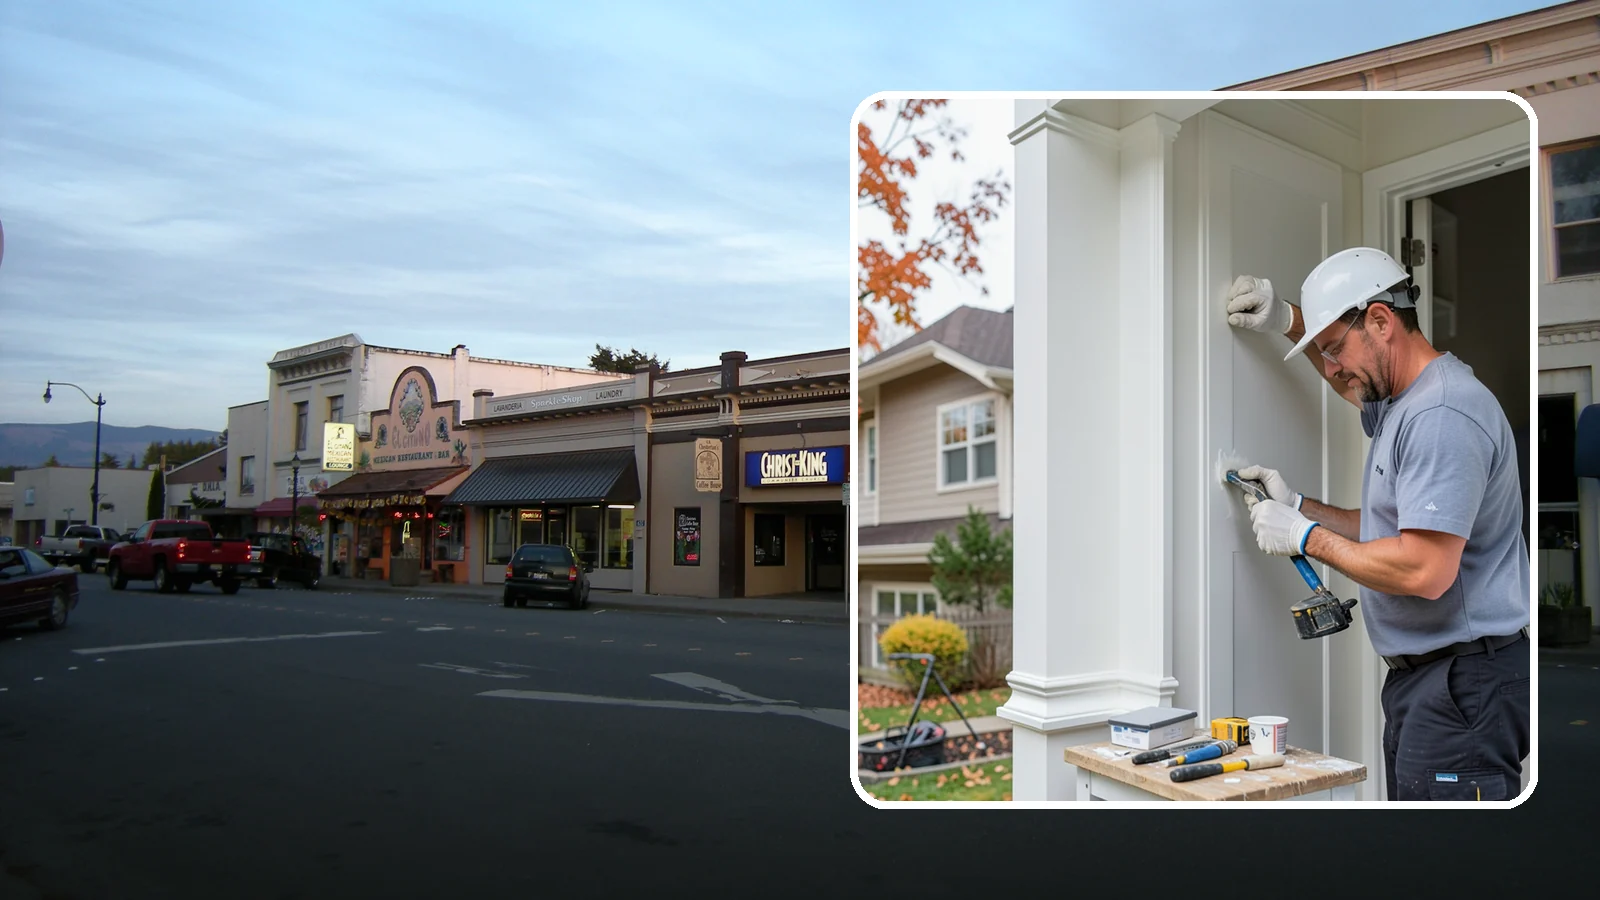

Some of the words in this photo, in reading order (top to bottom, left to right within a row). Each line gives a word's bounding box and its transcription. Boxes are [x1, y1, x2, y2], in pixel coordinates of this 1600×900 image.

[595, 389, 623, 400] LAUNDRY
[493, 402, 523, 412] LAVANDERIA
[531, 398, 560, 409] Sparkle
[562, 394, 583, 405] Shop
[397, 451, 433, 462] RESTAURANT
[438, 450, 450, 459] BAR
[761, 452, 797, 478] CHRIST
[799, 450, 827, 476] KING
